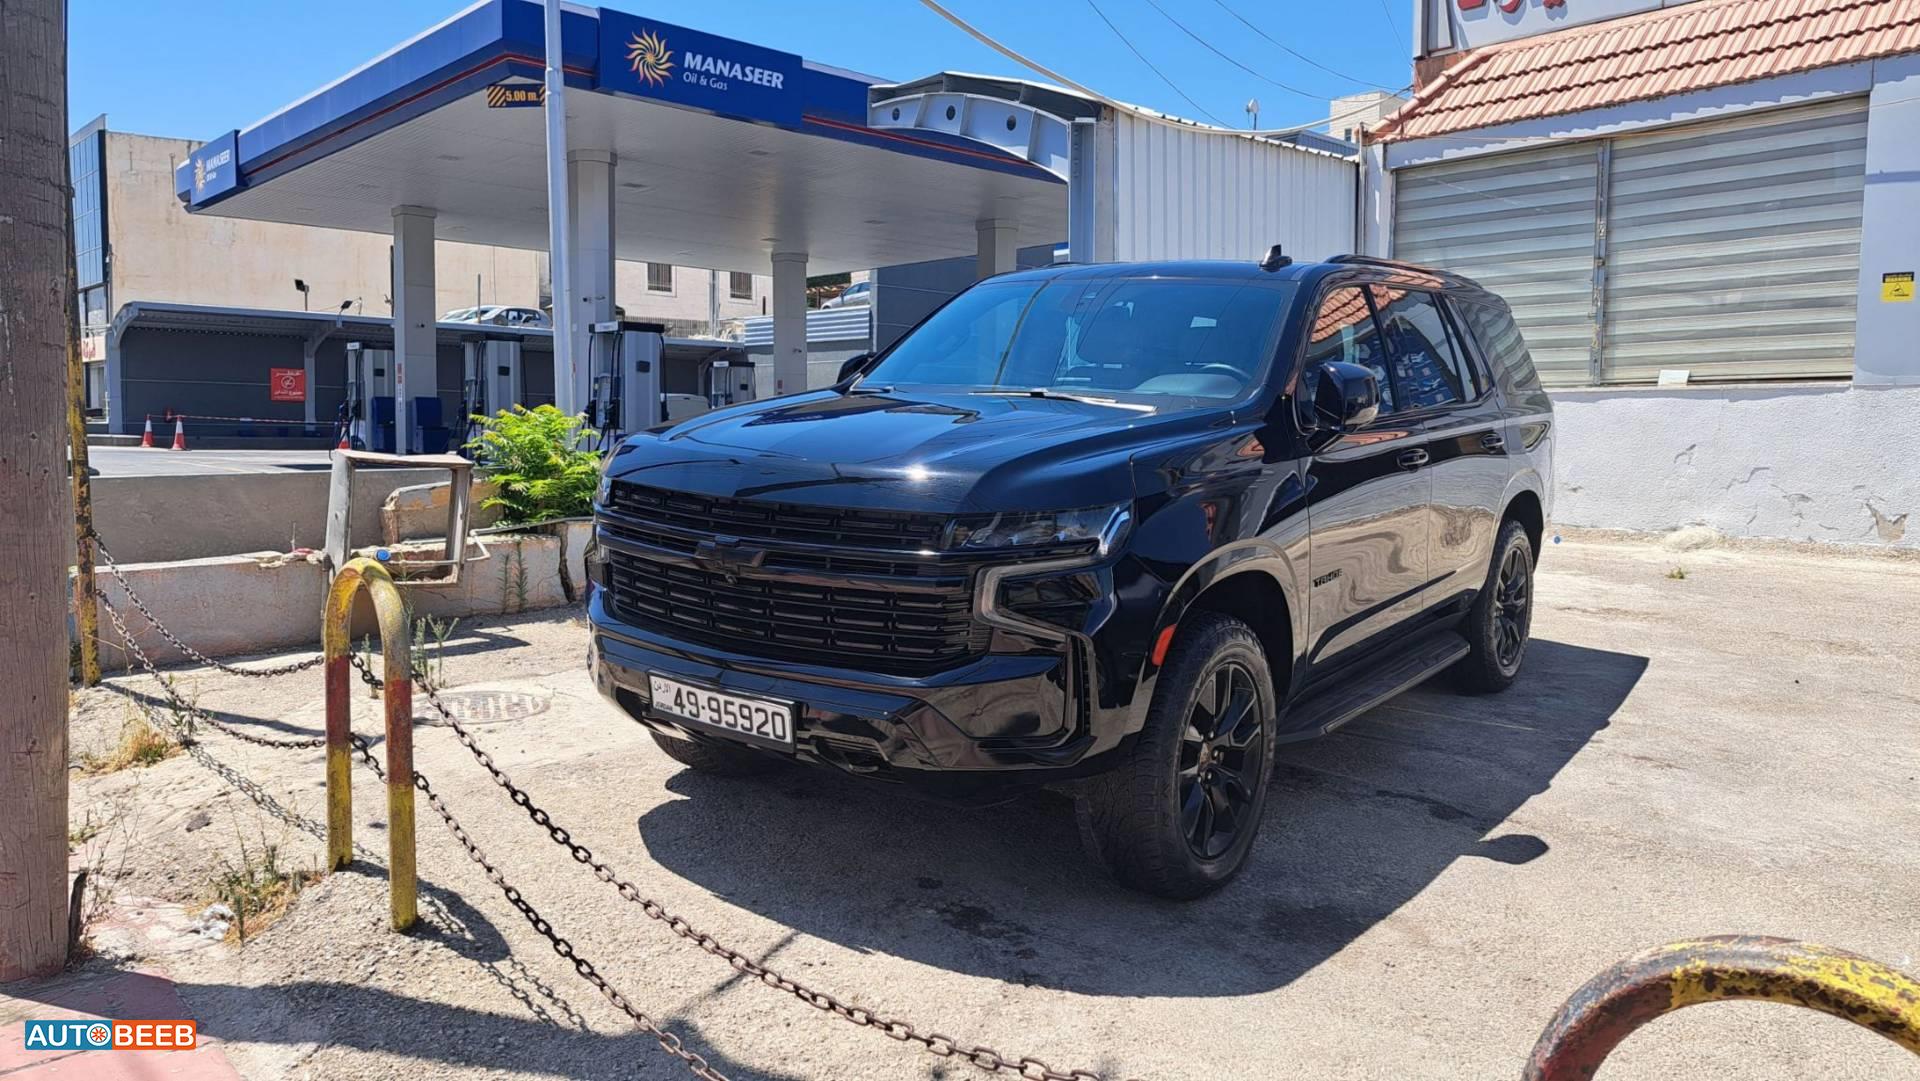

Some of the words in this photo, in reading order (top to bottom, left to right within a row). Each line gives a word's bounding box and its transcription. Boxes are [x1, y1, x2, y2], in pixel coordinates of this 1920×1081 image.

[683, 52, 784, 89] MANASEER
[683, 72, 697, 84] Oil
[699, 75, 708, 86] &
[709, 77, 728, 91] Gas
[505, 90, 526, 102] 5.00
[1313, 568, 1342, 587] TAHOE
[674, 687, 787, 740] 49-95920
